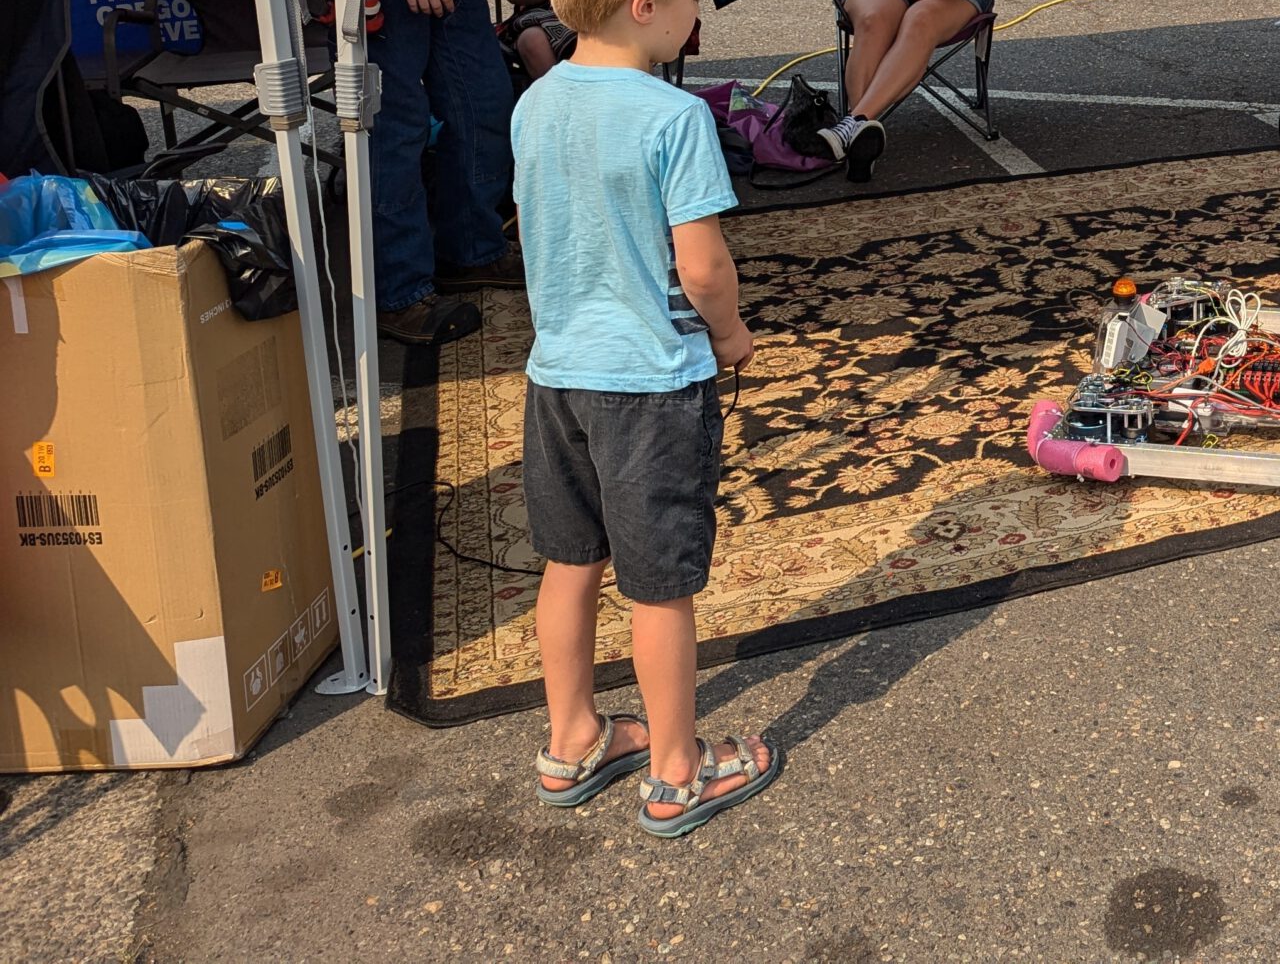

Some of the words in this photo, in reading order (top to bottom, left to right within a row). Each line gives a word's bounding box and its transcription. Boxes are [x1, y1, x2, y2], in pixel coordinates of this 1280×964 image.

[199, 301, 225, 324] INCHES
[38, 465, 51, 473] B
[19, 531, 103, 548] ES10353US-BK
